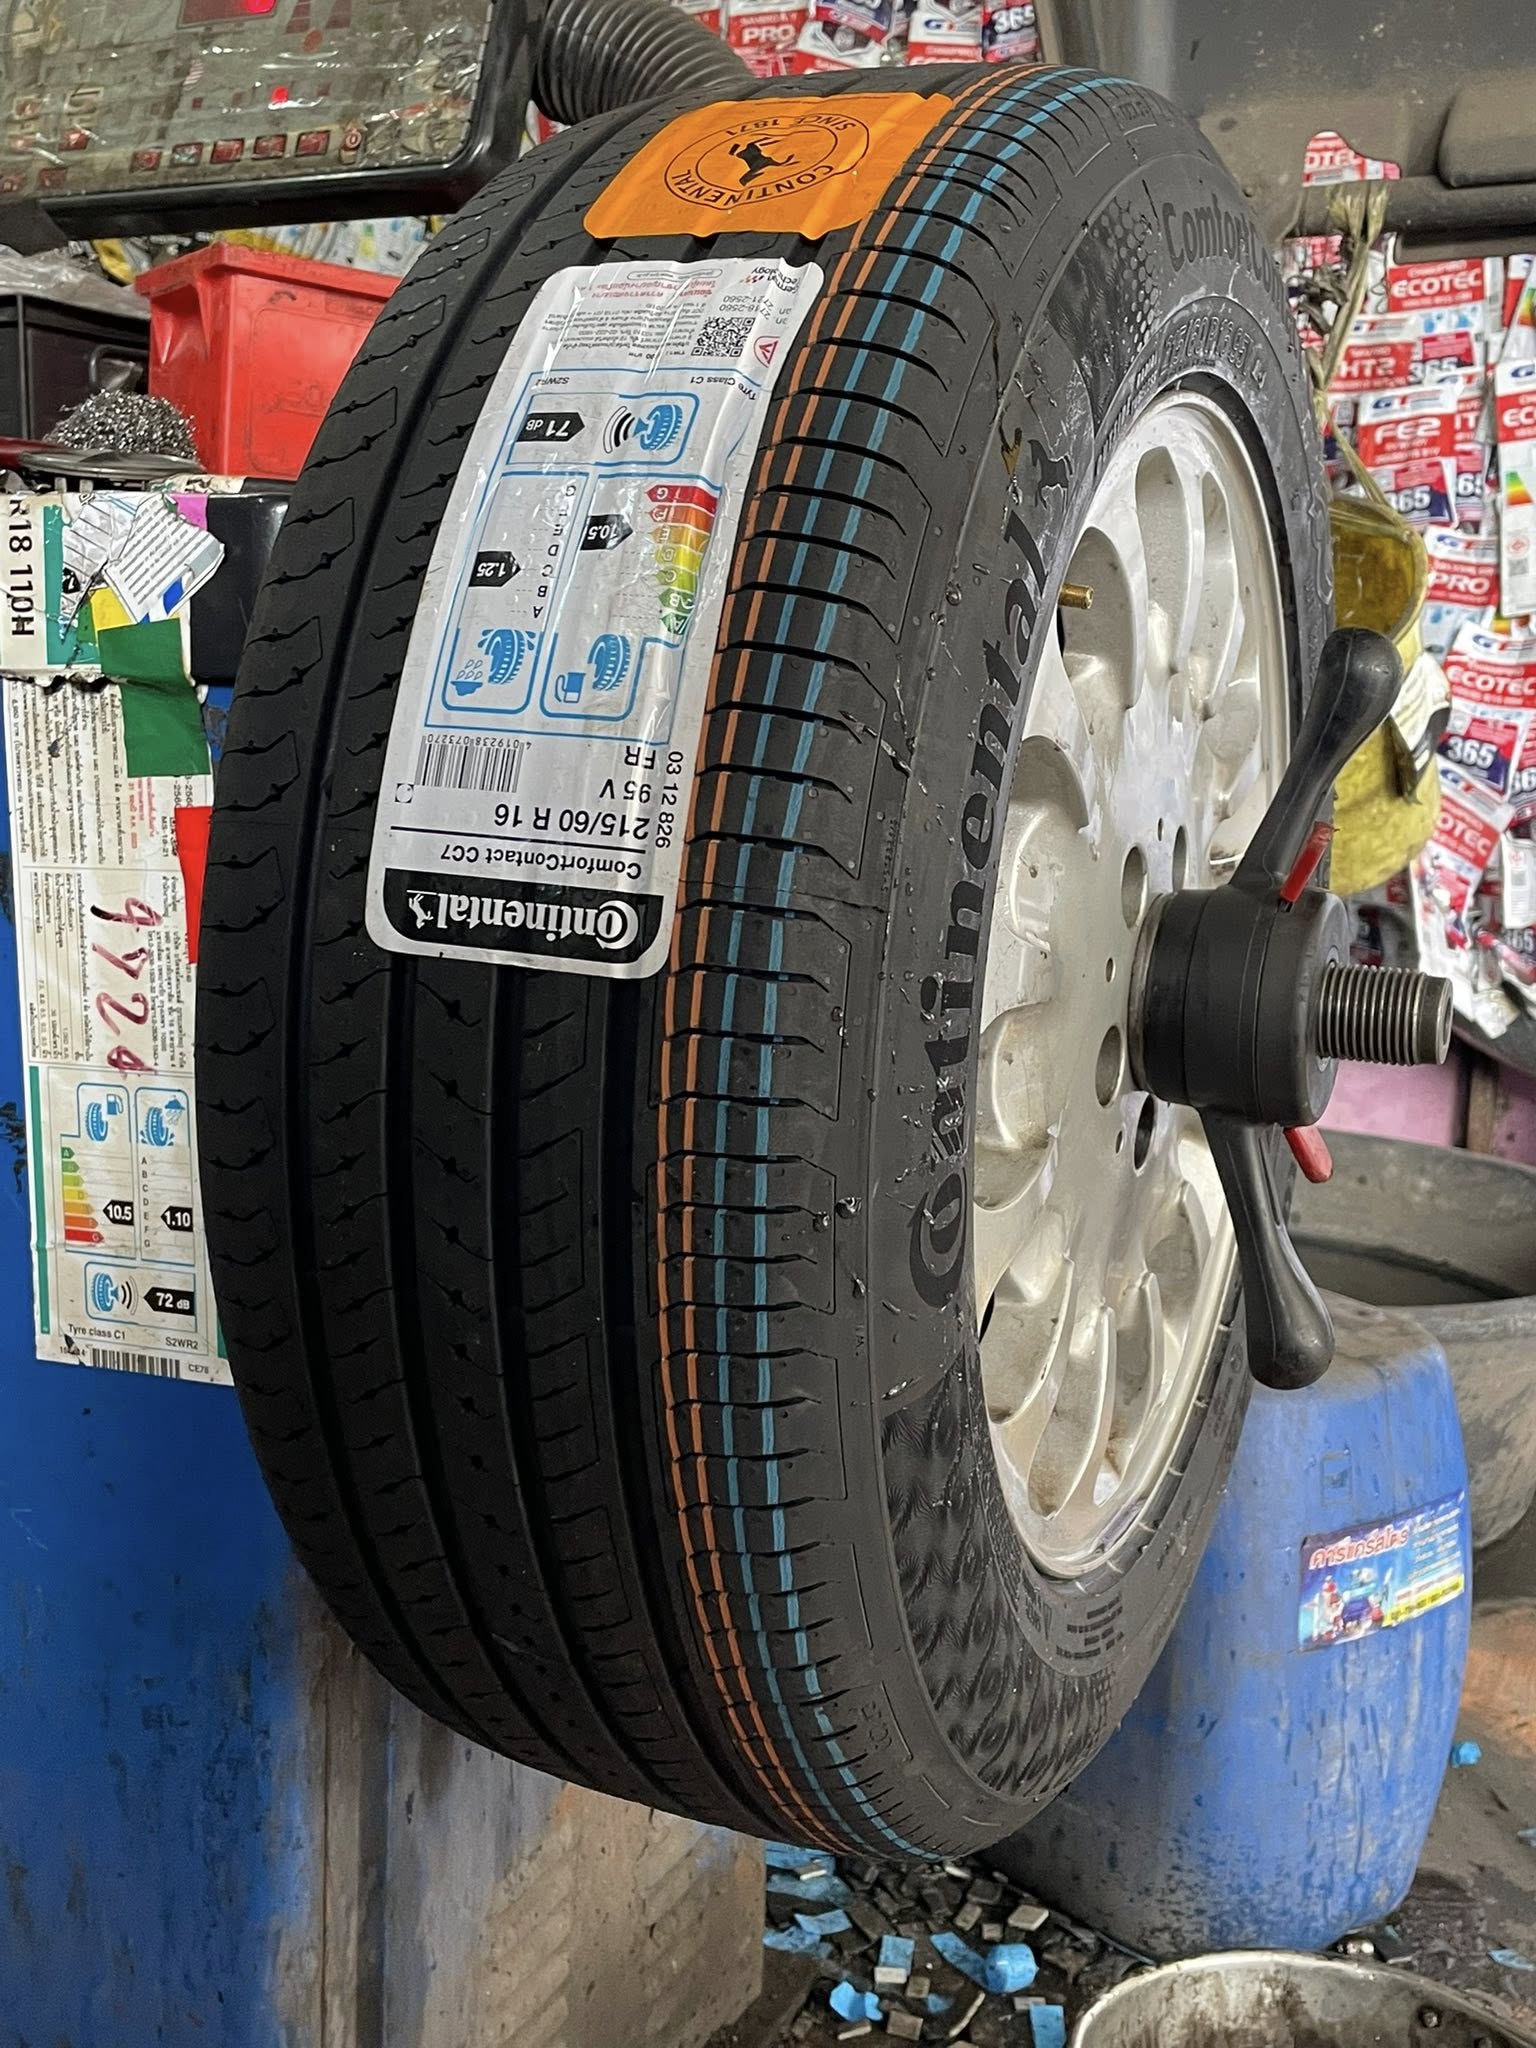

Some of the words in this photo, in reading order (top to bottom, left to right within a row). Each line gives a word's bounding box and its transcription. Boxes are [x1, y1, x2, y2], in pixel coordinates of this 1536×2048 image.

[742, 24, 796, 45] PRO
[724, 119, 781, 137] 1871
[793, 115, 857, 132] SINCE
[671, 165, 836, 207] CONTINENTAL
[1390, 268, 1483, 299] ECOTEC
[1340, 357, 1396, 380] HT2
[690, 376, 705, 385] C1
[705, 376, 736, 386] Class
[737, 383, 756, 401] Tyre
[524, 420, 544, 432] dB
[546, 421, 571, 438] 71
[1374, 416, 1441, 445] FE2
[587, 524, 618, 540] 10.5
[547, 544, 559, 556] D
[477, 562, 507, 578] 1.25
[541, 564, 553, 577] C
[537, 584, 548, 597] B
[1427, 570, 1491, 596] PRO
[9, 564, 35, 637] 110H
[532, 605, 543, 618] A
[1446, 666, 1536, 696] ECOTEC
[623, 746, 656, 770] FR
[1446, 733, 1498, 769] 365
[666, 751, 683, 775] 03
[600, 779, 616, 799] V
[623, 780, 653, 804] 95
[661, 783, 677, 806] 12
[493, 804, 522, 828] 16
[533, 807, 552, 830] R
[559, 809, 650, 840] 215/60
[654, 812, 674, 849] 826
[440, 844, 480, 864] CC7
[485, 848, 642, 880] ComfortContact
[908, 512, 1047, 1308] Continental
[438, 894, 639, 949] Continental
[106, 1204, 132, 1220] 10.5
[164, 1210, 191, 1227] 1.10
[155, 1291, 174, 1308] 72
[67, 1323, 87, 1337] Tyre
[88, 1327, 112, 1339] class
[113, 1330, 126, 1340] C1
[164, 1337, 199, 1350] S2WR2
